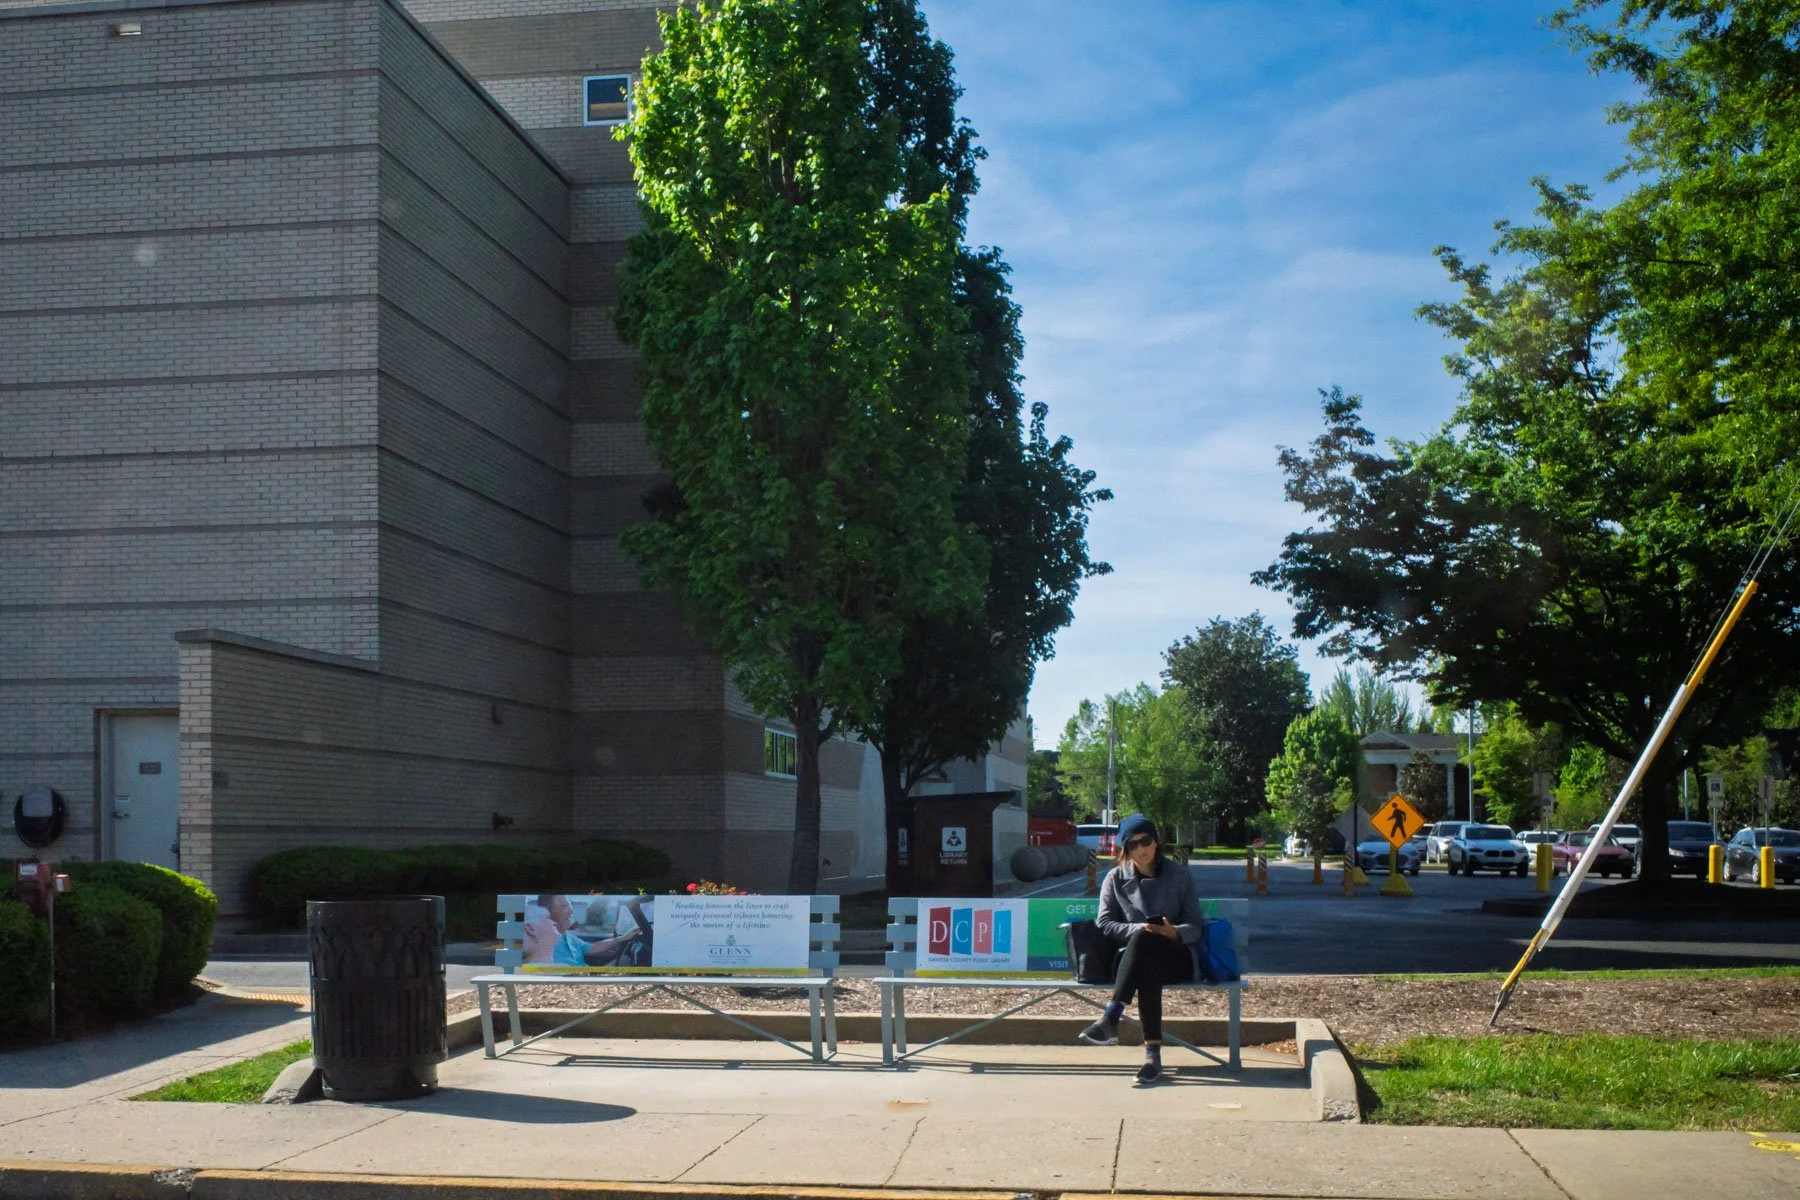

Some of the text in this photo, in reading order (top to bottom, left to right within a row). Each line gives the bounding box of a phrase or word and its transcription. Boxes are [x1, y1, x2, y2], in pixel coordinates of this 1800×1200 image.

[675, 902, 704, 911] Reading
[734, 901, 744, 909] the
[772, 902, 789, 911] craft
[1066, 904, 1087, 914] GET
[670, 912, 700, 921] uniquely
[702, 912, 732, 921] personal
[761, 911, 793, 920] honoring
[725, 922, 734, 930] of
[1049, 960, 1069, 968] VISIT
